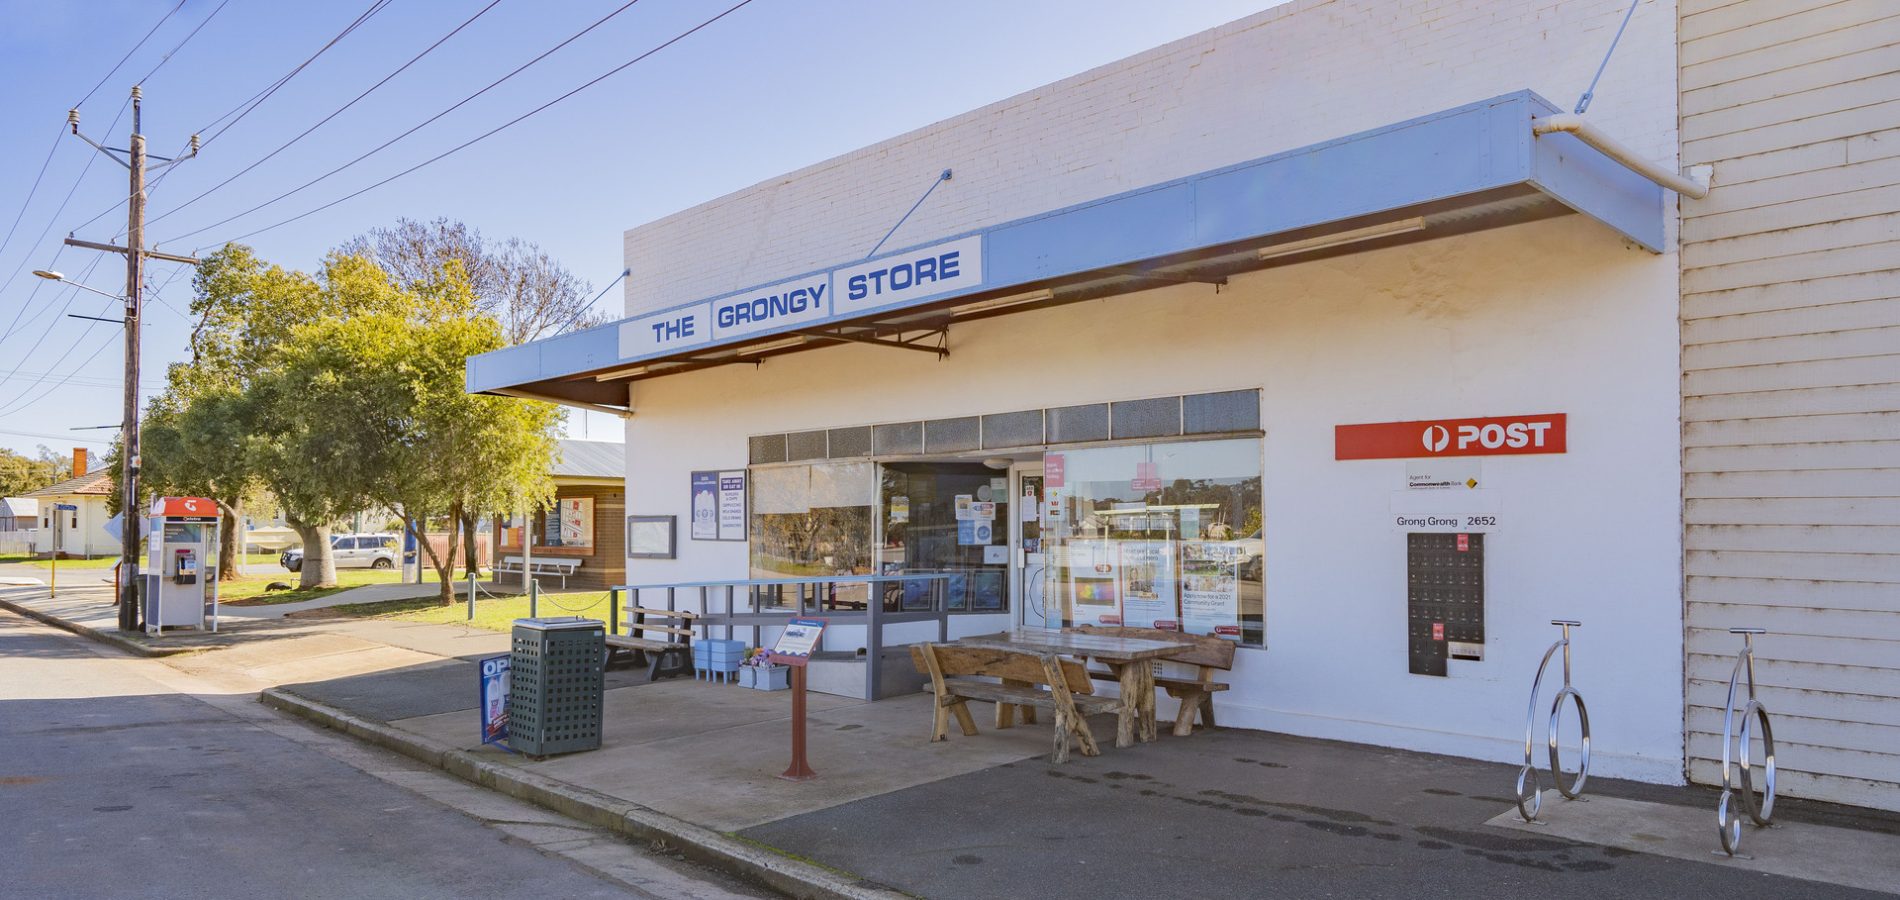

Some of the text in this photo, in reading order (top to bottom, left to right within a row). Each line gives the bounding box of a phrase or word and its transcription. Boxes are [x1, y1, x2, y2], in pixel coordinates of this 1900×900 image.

[652, 251, 960, 343] THE GRONGY STORE
[1458, 422, 1551, 449] POST
[1397, 516, 1496, 527] Grong Grong 2652
[483, 659, 511, 676] OP
